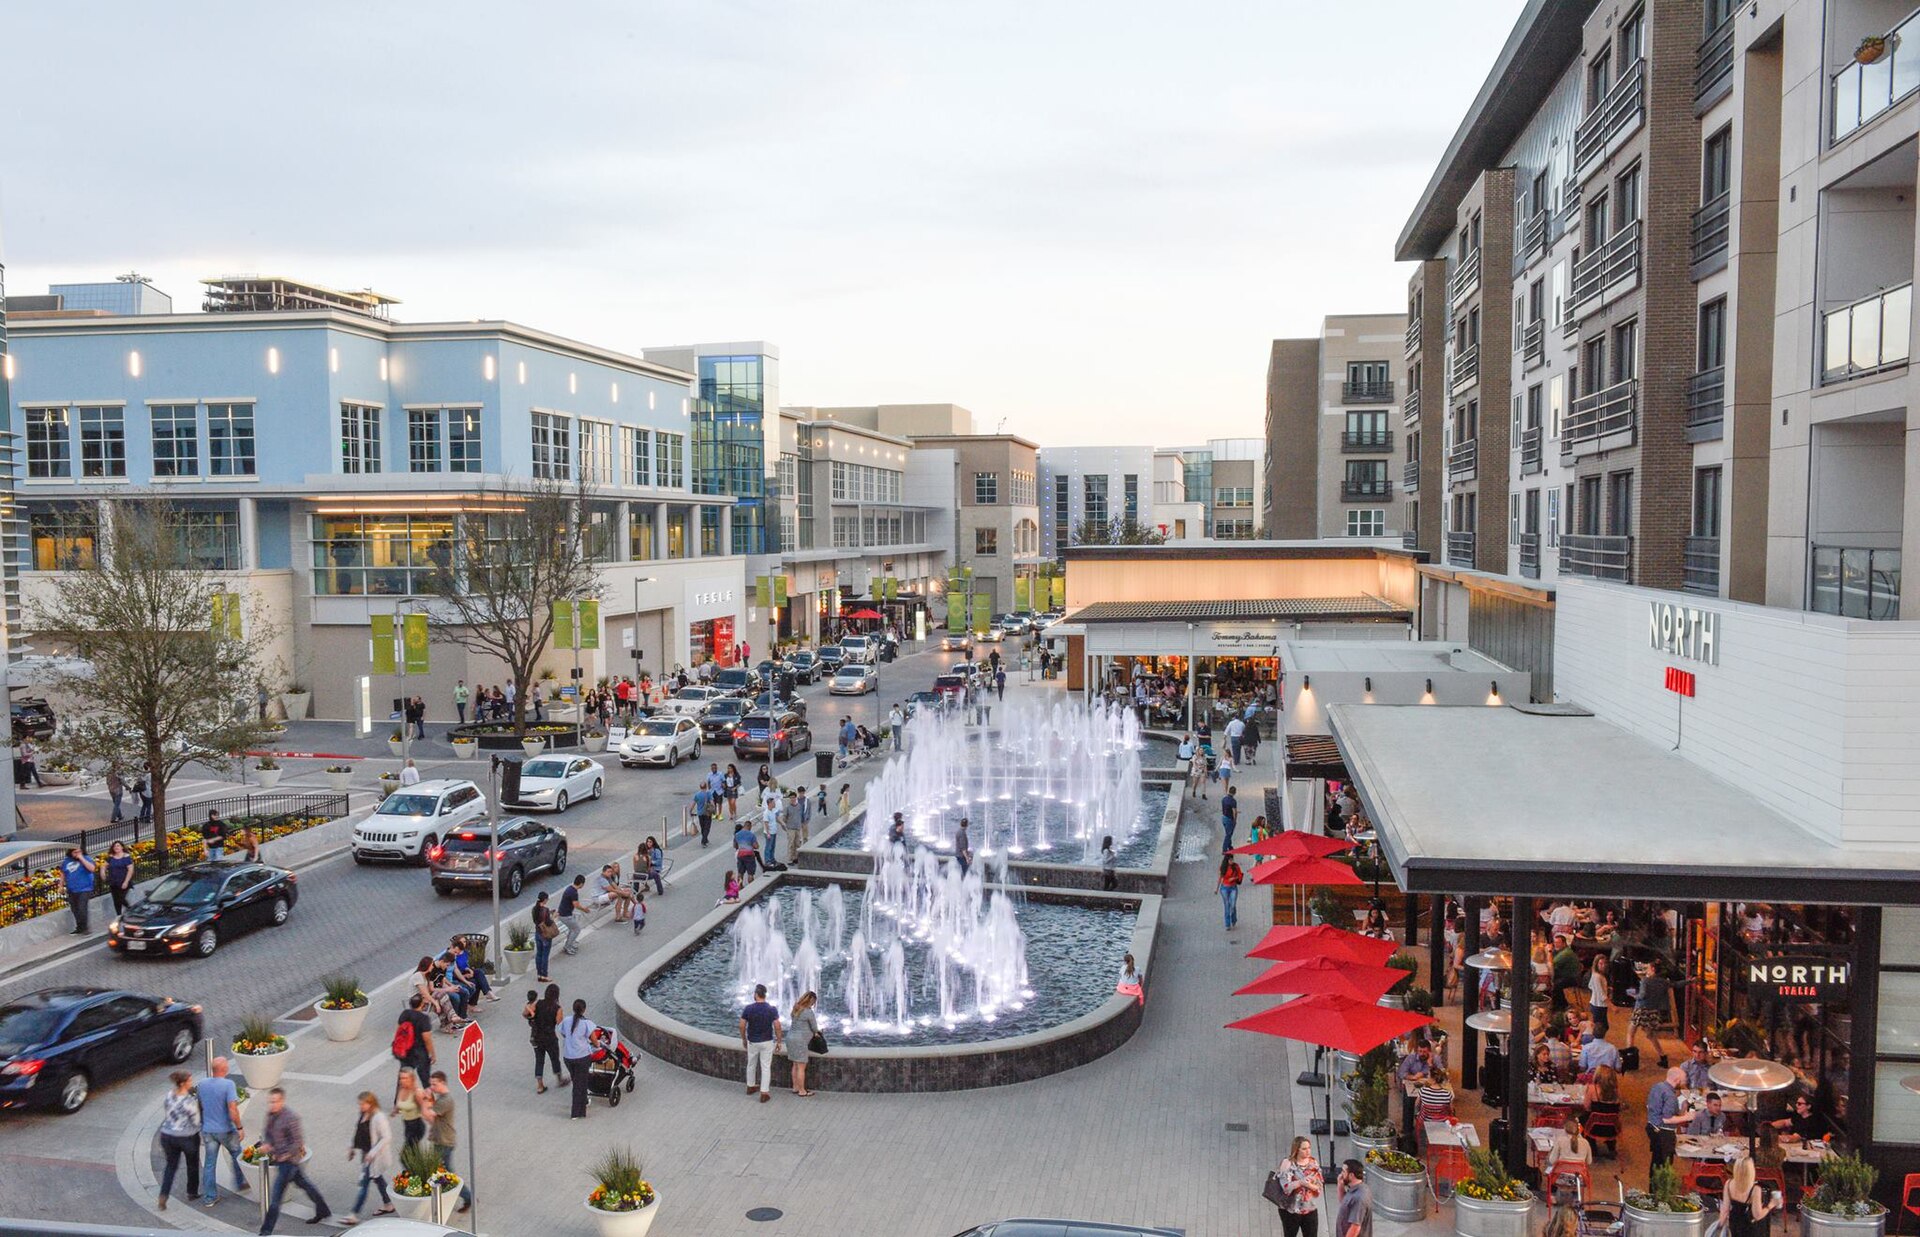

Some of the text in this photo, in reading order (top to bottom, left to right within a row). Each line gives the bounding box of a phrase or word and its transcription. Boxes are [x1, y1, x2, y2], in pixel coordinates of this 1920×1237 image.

[695, 590, 733, 605] TESLA
[1212, 631, 1277, 643] Tommy Bahama
[1649, 602, 1716, 665] NORTH
[1750, 965, 1846, 984] NORTH
[1779, 986, 1817, 996] ITALIA
[460, 1039, 482, 1075] STOP
